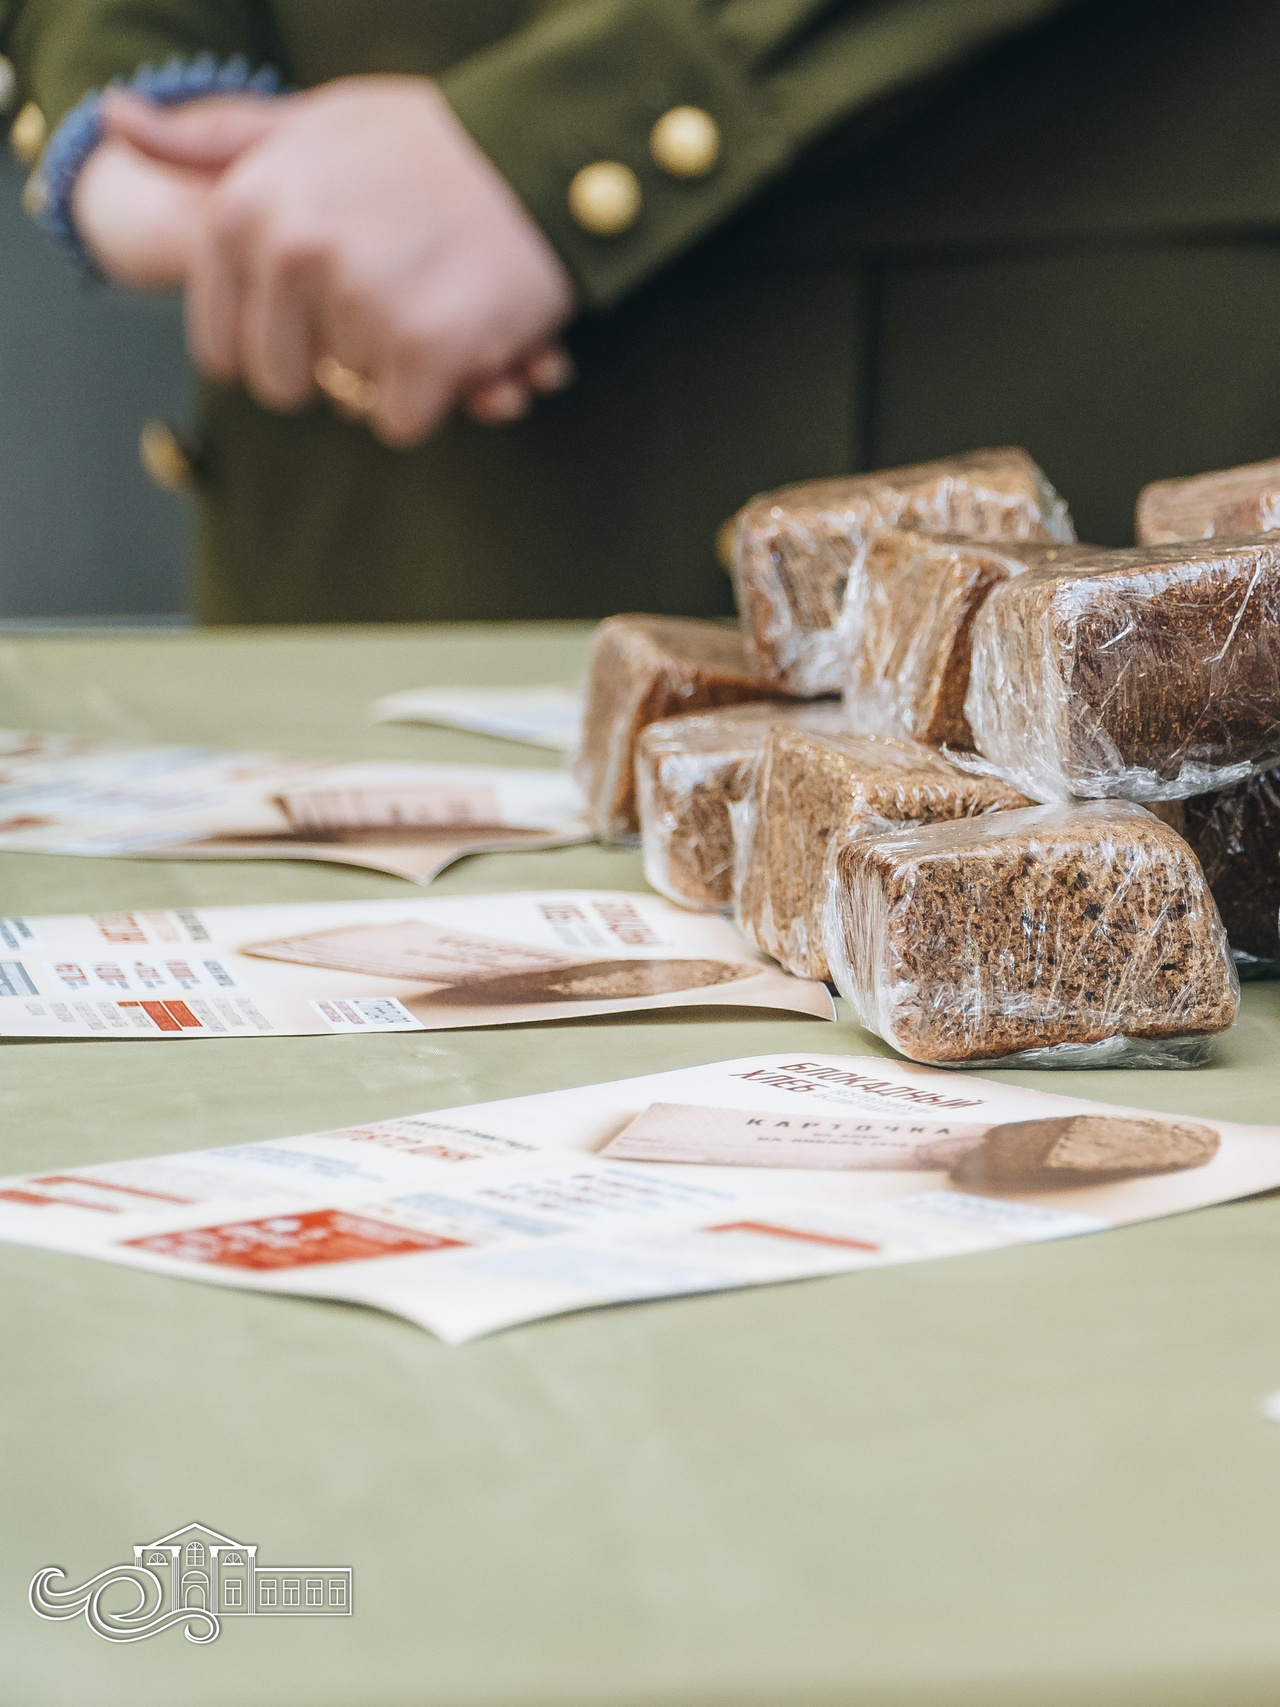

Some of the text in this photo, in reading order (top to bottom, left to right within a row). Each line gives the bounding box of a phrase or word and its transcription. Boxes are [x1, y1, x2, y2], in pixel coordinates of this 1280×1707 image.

[729, 1069, 829, 1093] ХЛЕБ
[776, 1062, 988, 1110] БЛОКАДНЫЙ
[746, 1118, 952, 1135] КАРТОЧКА
